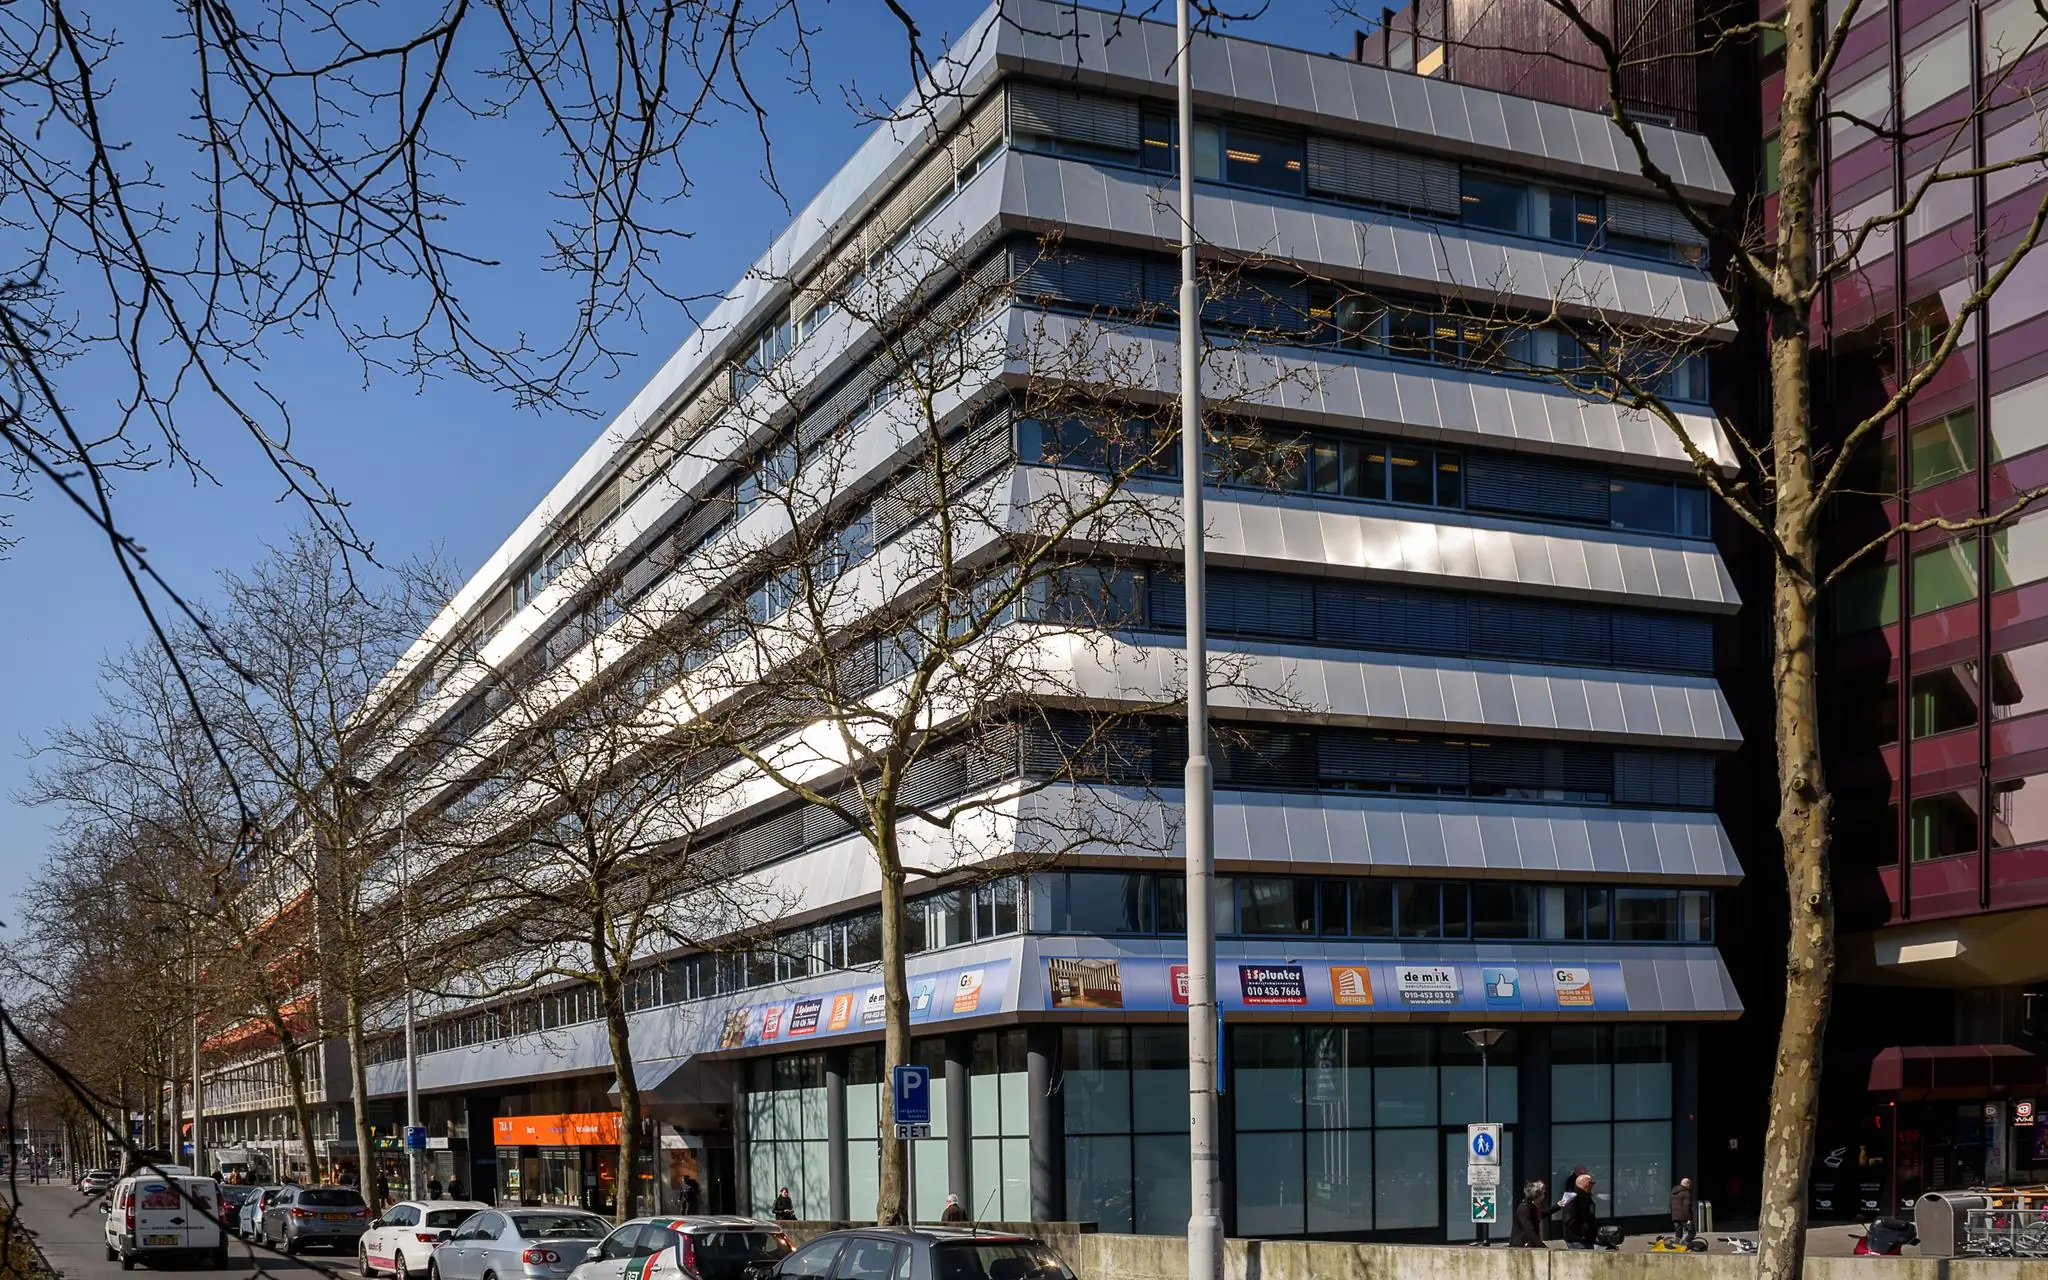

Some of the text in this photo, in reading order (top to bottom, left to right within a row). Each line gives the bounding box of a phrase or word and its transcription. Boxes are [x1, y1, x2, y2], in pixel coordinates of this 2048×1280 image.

[1253, 970, 1300, 982] Splunter
[1404, 968, 1450, 982] de mik
[1556, 970, 1574, 982] Gs
[1247, 986, 1301, 996] 010 436 7666
[1404, 991, 1434, 999] 010-453
[903, 1071, 922, 1099] P
[1191, 1117, 1196, 1125] 3
[899, 1126, 928, 1138] RET
